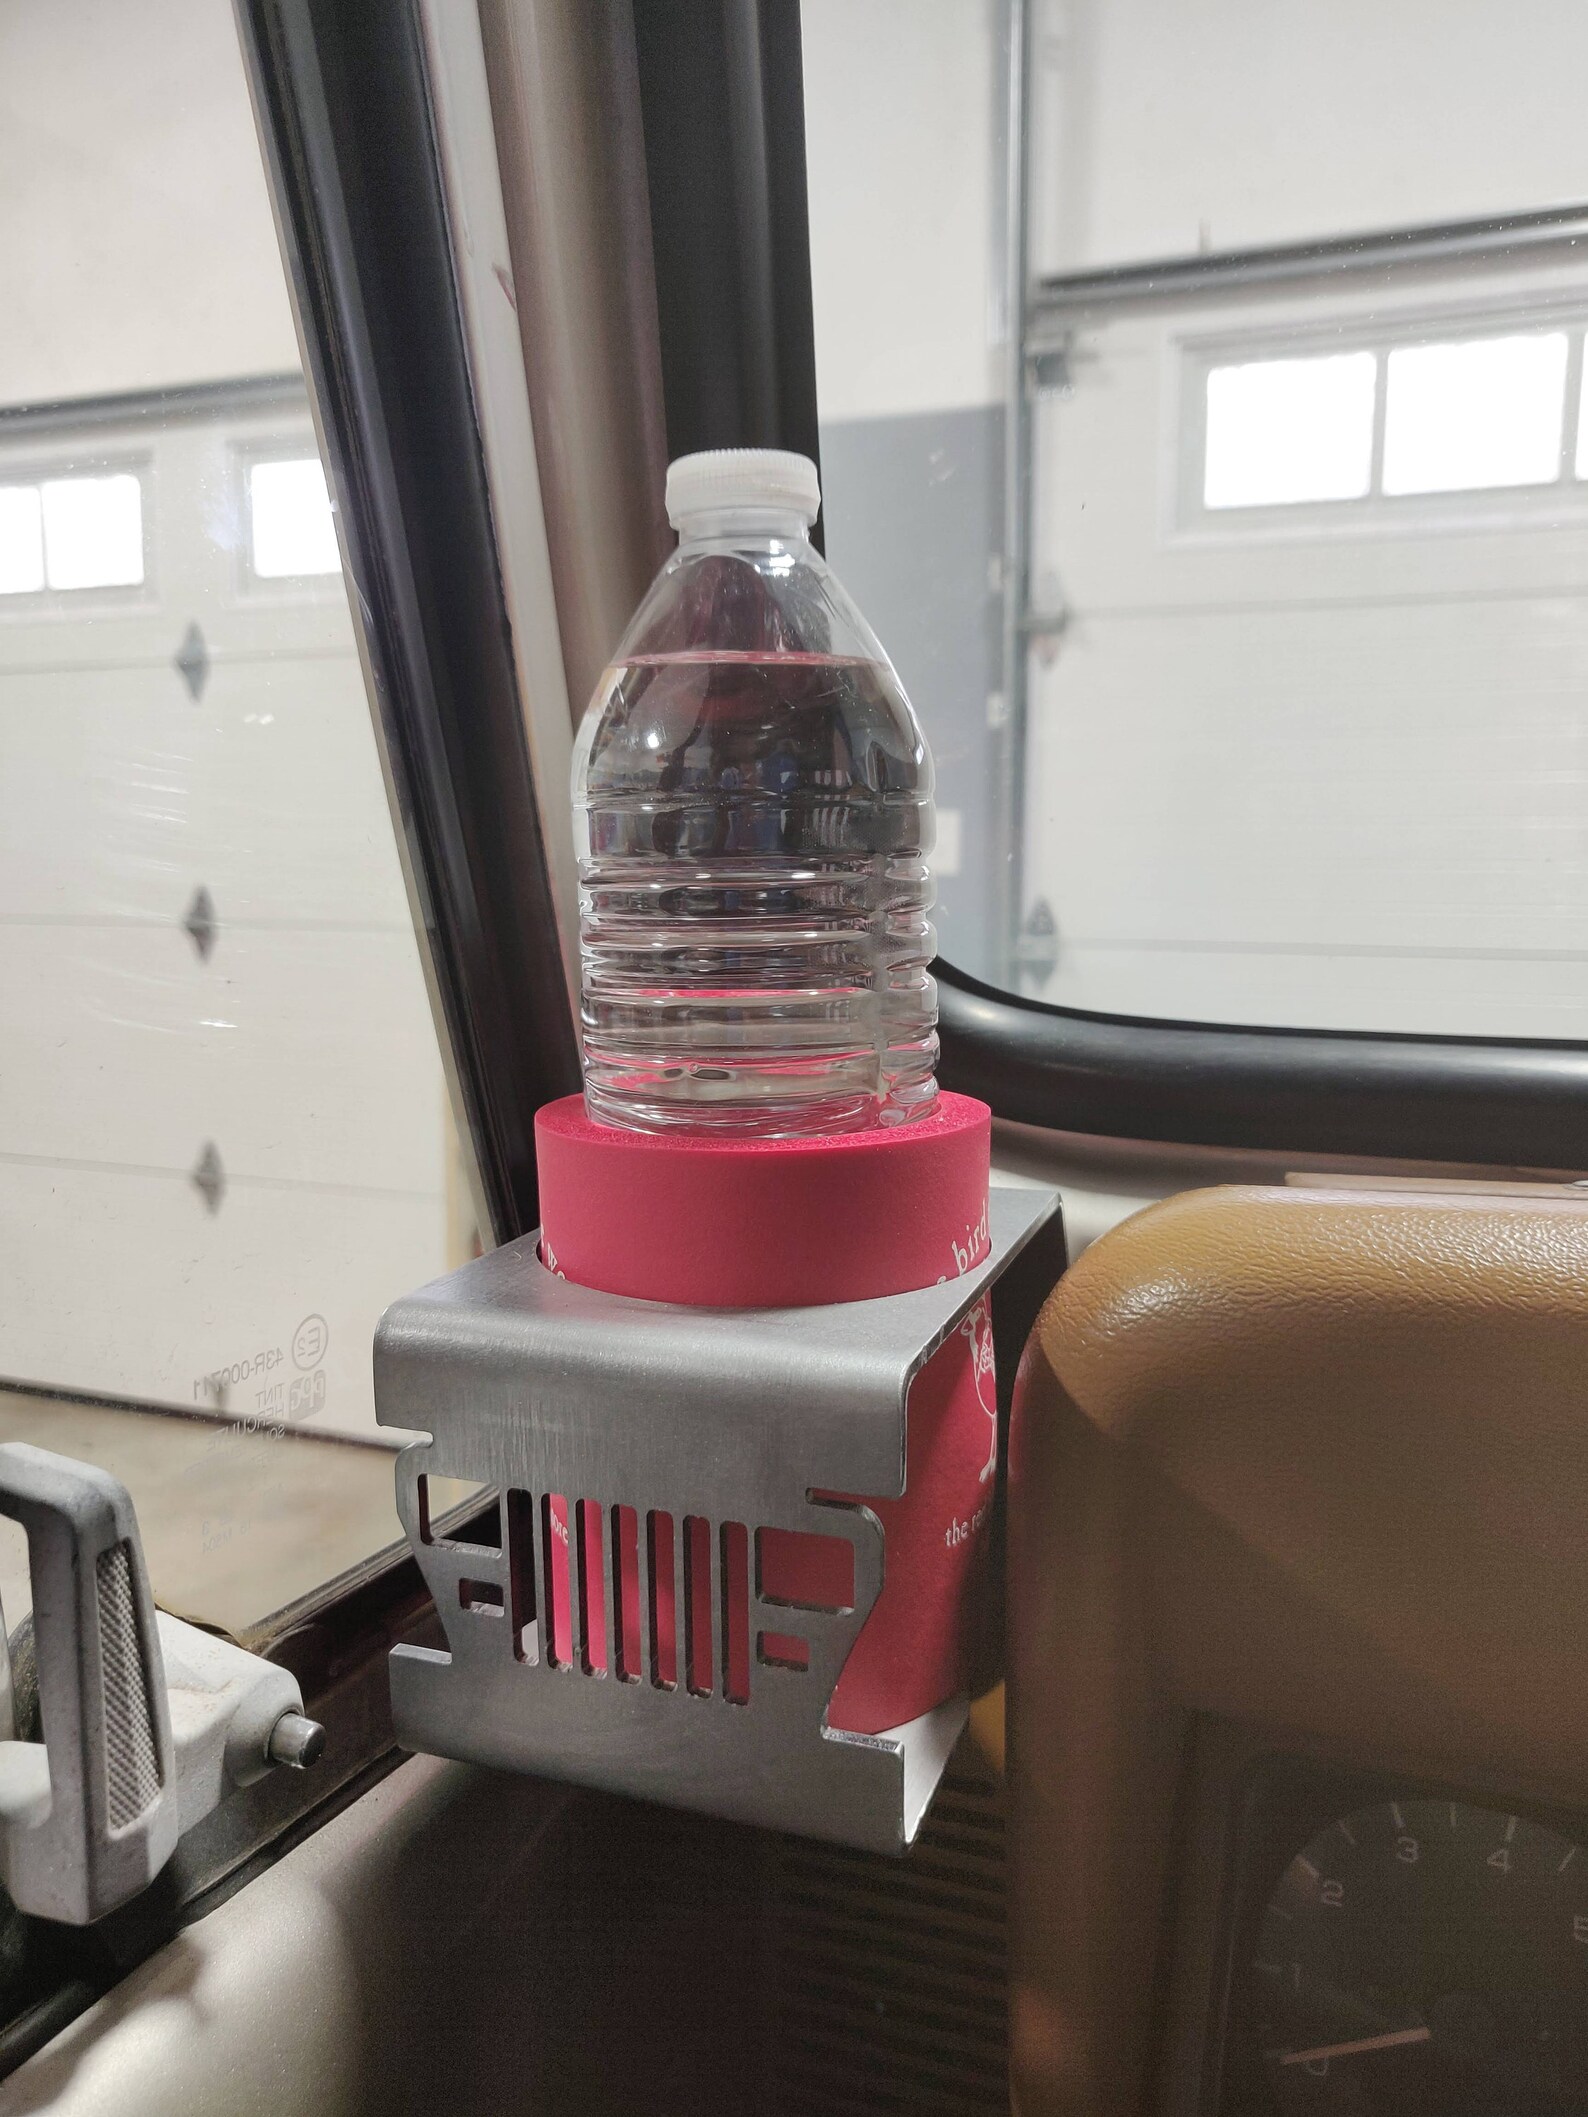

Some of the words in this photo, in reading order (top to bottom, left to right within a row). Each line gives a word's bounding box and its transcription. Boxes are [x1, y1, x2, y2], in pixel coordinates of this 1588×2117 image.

[951, 1197, 987, 1275] bird
[945, 1516, 968, 1547] the
[1397, 1836, 1420, 1863] 3
[1486, 1848, 1511, 1873] 4
[1321, 1879, 1344, 1907] 2
